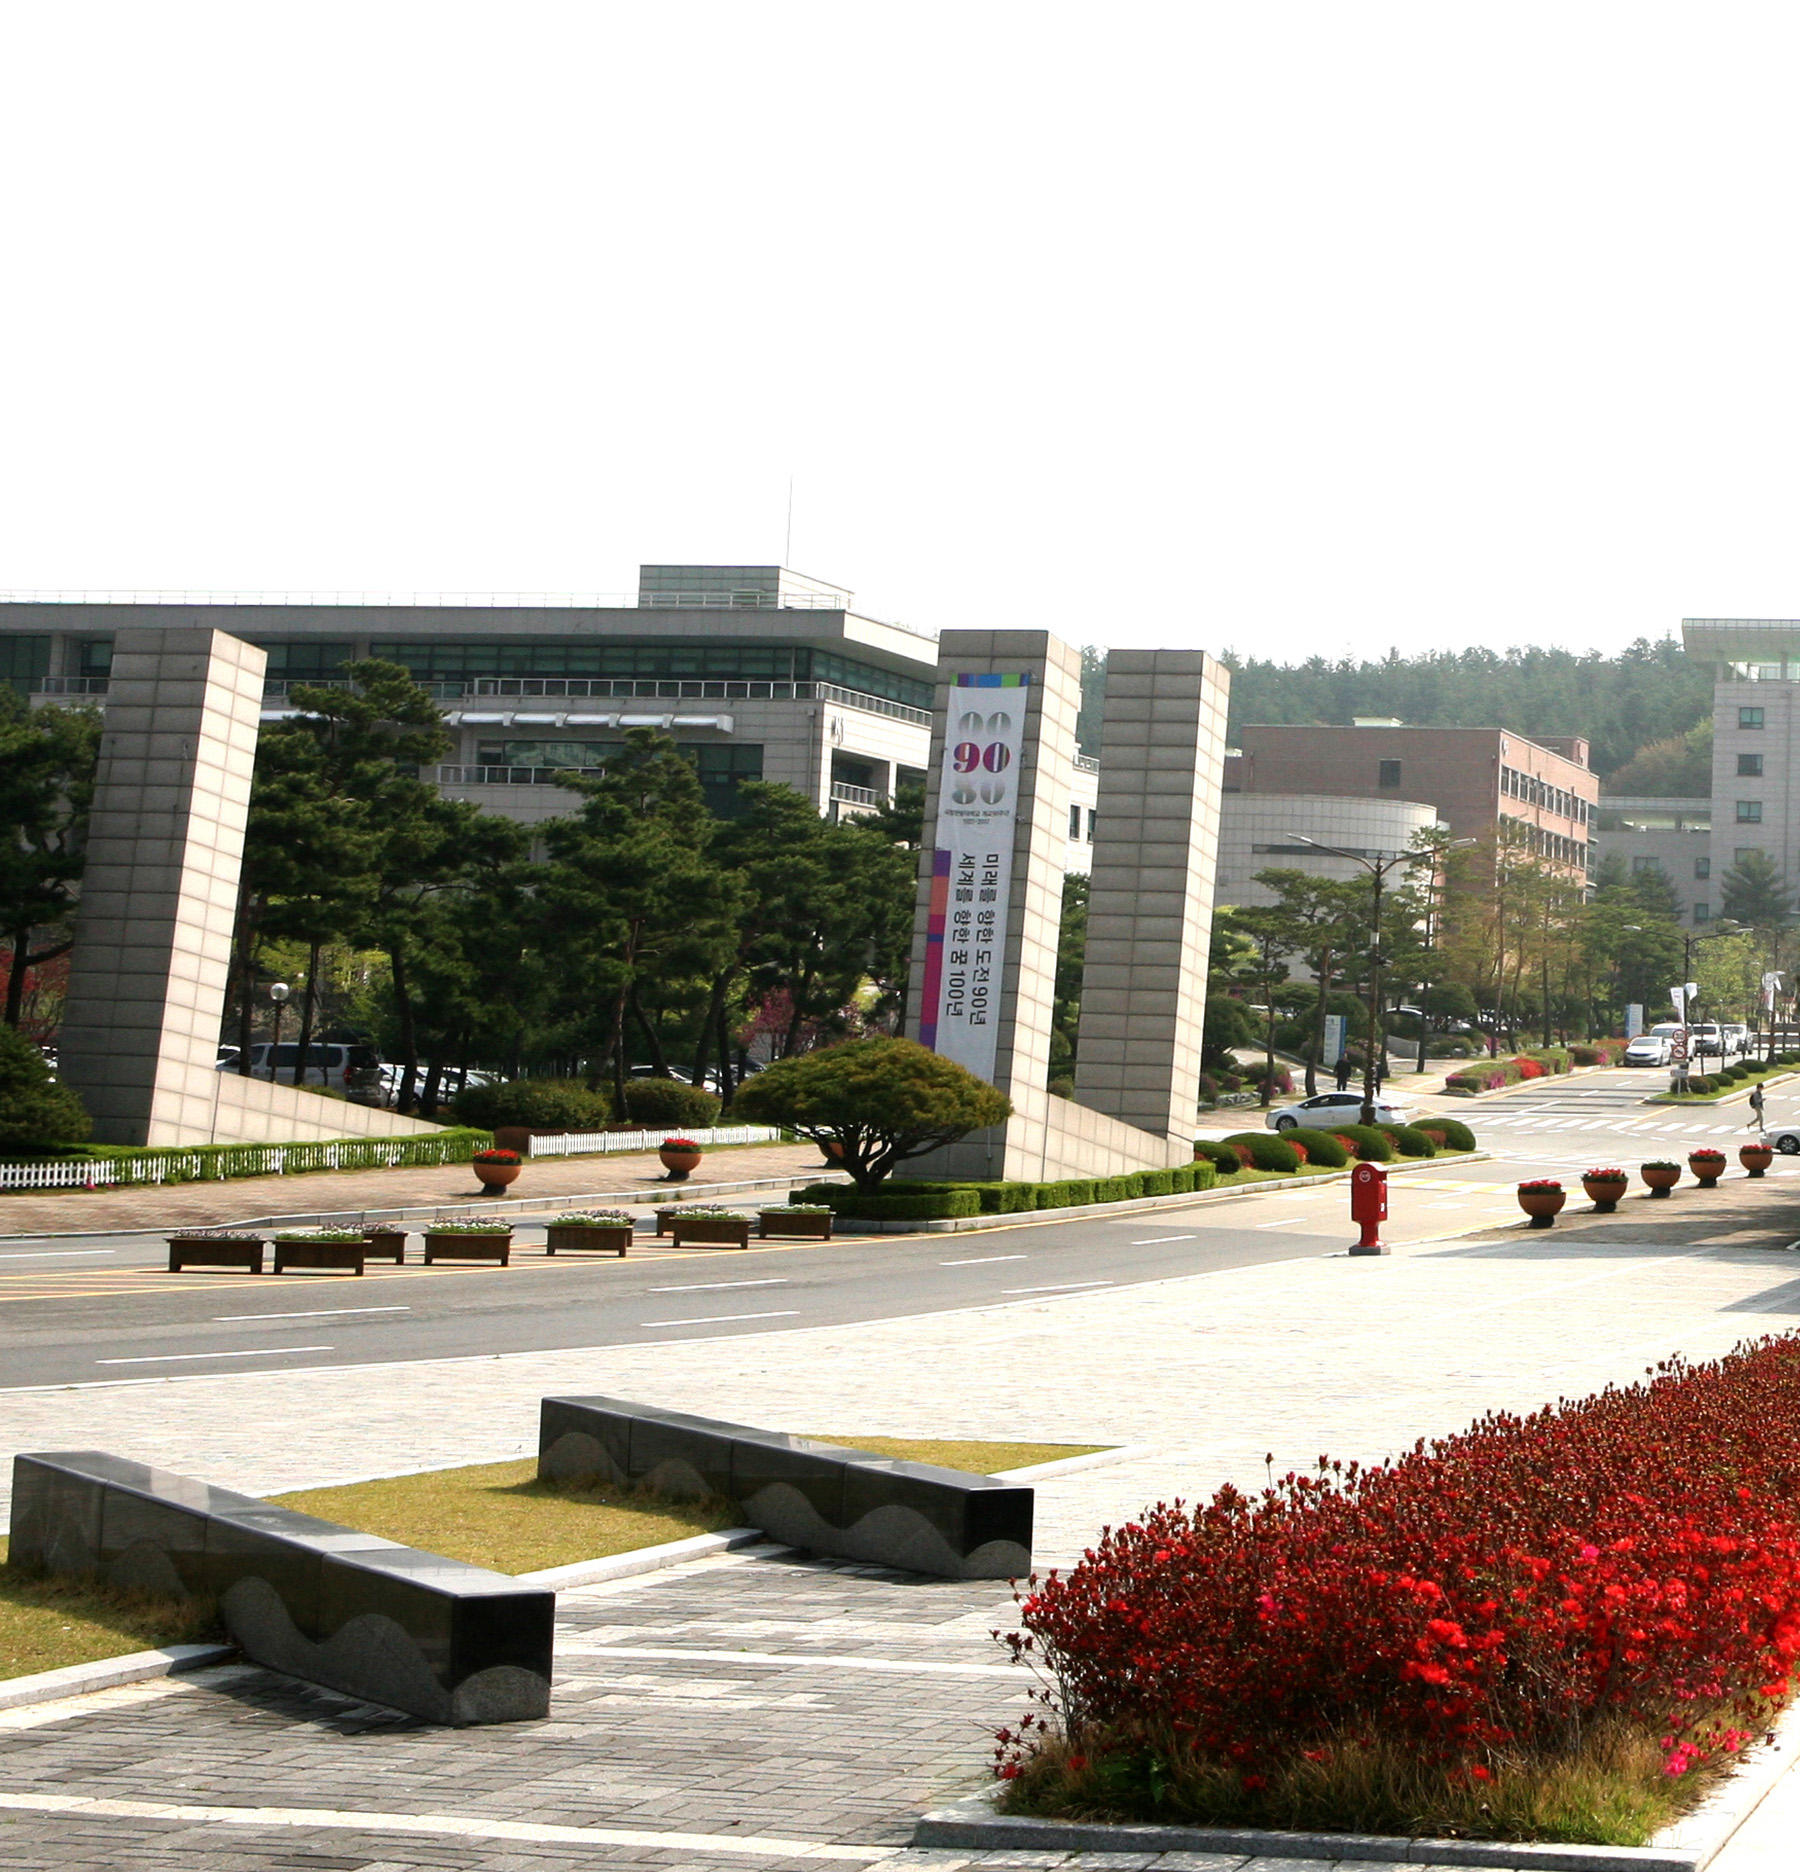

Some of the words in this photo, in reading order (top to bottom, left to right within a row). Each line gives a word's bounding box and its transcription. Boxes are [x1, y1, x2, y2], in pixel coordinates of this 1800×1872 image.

[953, 742, 1010, 773] 90
[955, 853, 976, 904] 세계를
[979, 853, 1000, 904] 미래를
[952, 909, 972, 943] 향한
[976, 909, 996, 944] 향한
